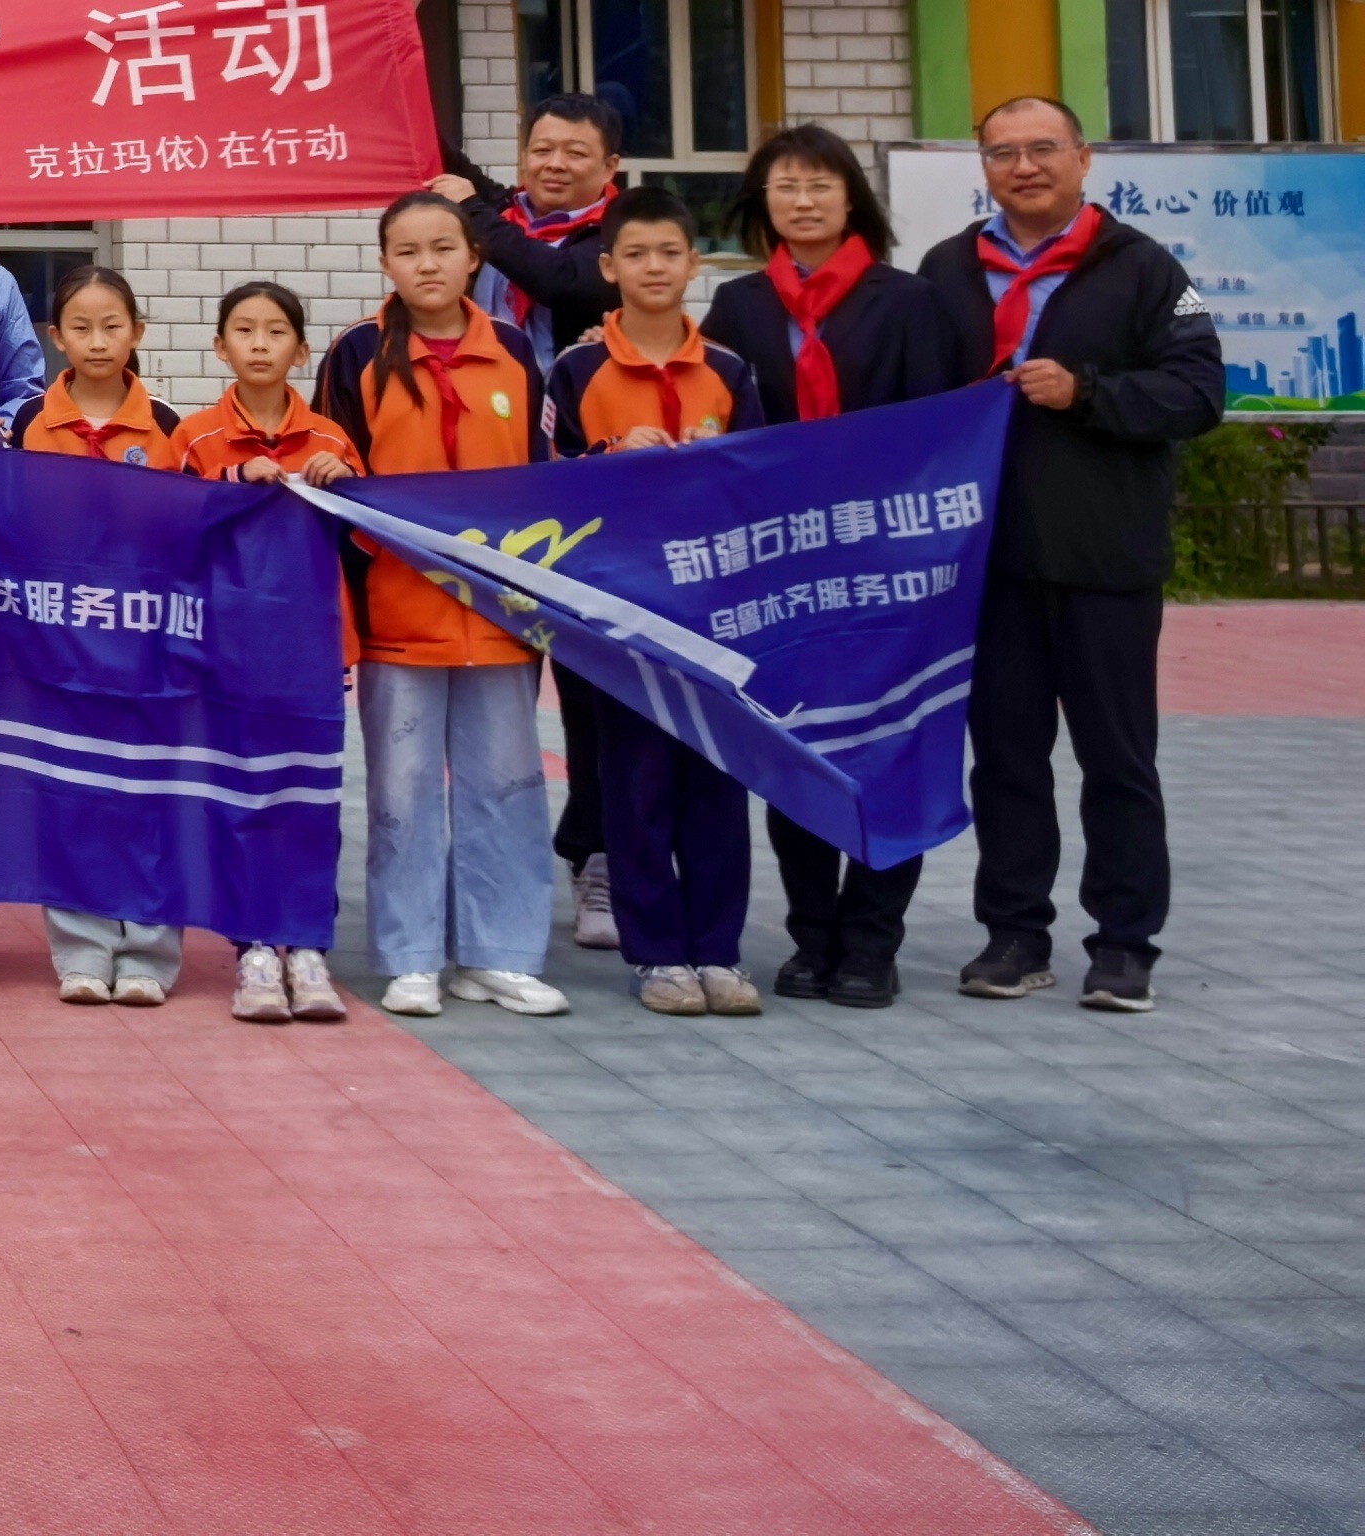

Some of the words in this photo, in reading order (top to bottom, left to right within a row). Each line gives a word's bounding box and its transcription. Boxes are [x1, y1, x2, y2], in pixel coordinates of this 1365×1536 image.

[662, 482, 983, 585] 新疆石油事业部
[710, 563, 960, 640] 乌鲁木齐服务中心
